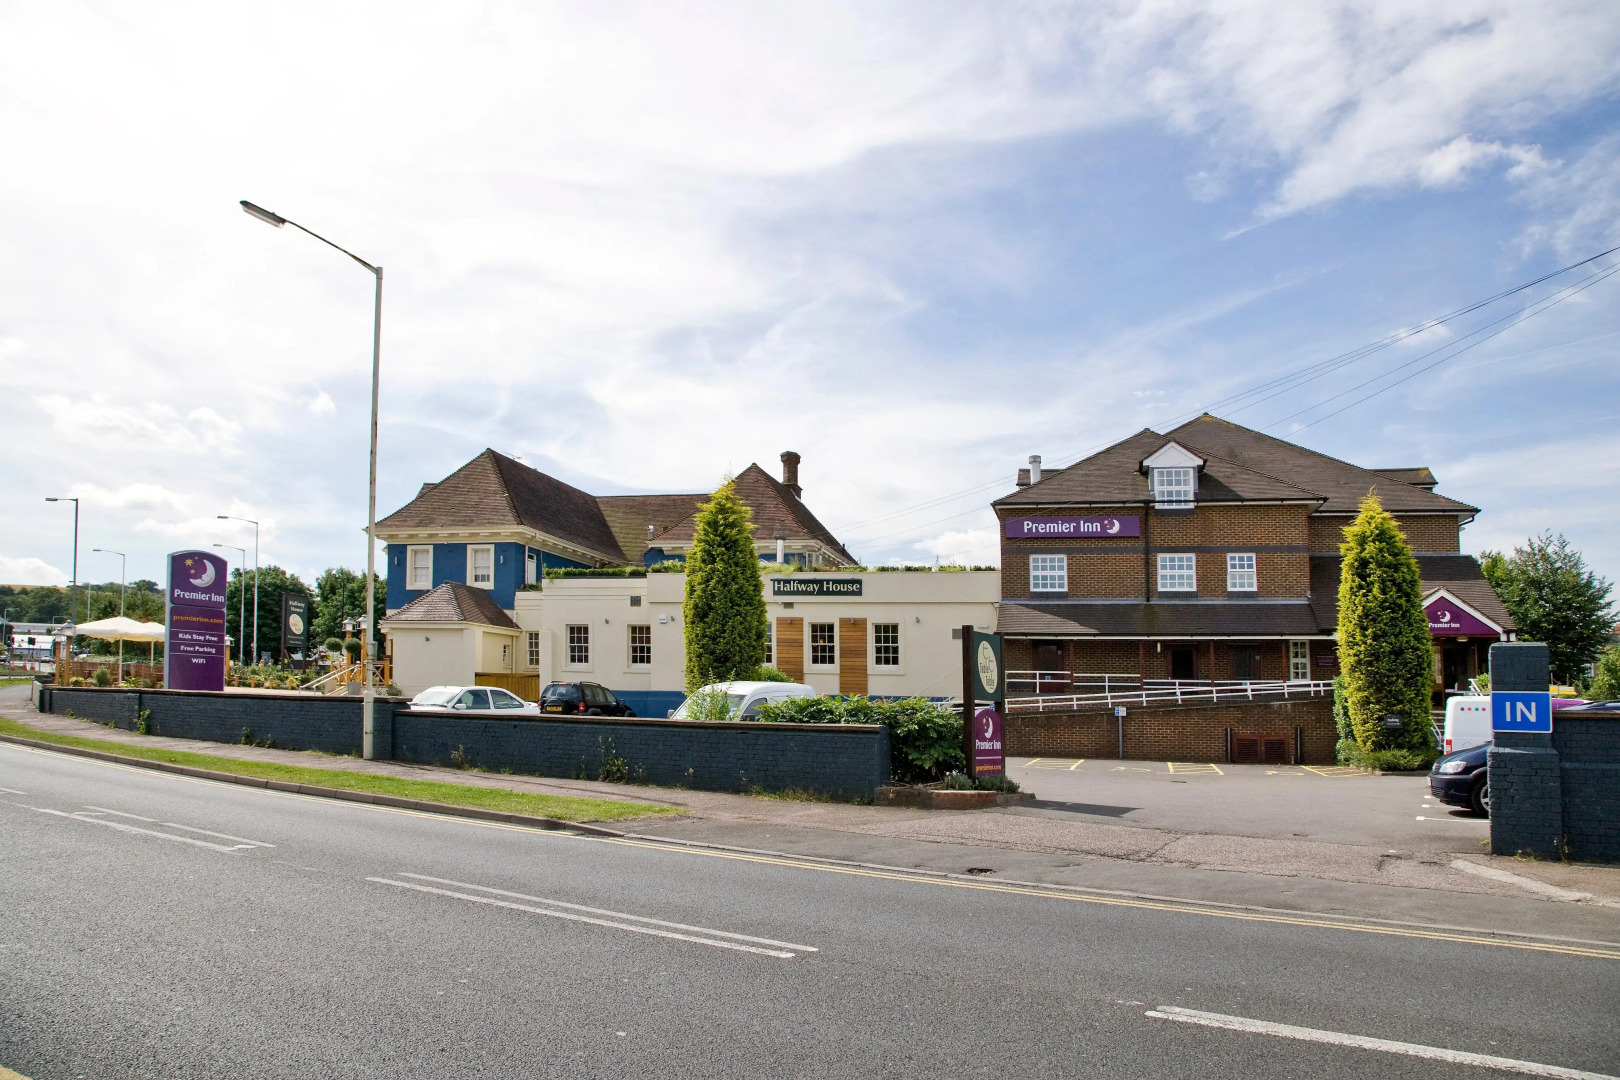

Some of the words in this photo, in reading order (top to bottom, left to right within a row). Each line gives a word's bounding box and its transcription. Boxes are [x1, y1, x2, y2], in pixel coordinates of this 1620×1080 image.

[1023, 520, 1076, 533] Premier
[1080, 520, 1101, 532] Inn
[774, 581, 820, 595] Halfway
[823, 581, 860, 592] House
[174, 589, 210, 600] Premier
[211, 593, 225, 602] Inn
[173, 615, 223, 624] premierinn.com
[979, 662, 989, 673] Table
[985, 675, 995, 686] Table
[1505, 701, 1537, 722] IN
[975, 739, 993, 750] Premier
[993, 740, 1001, 750] Inn
